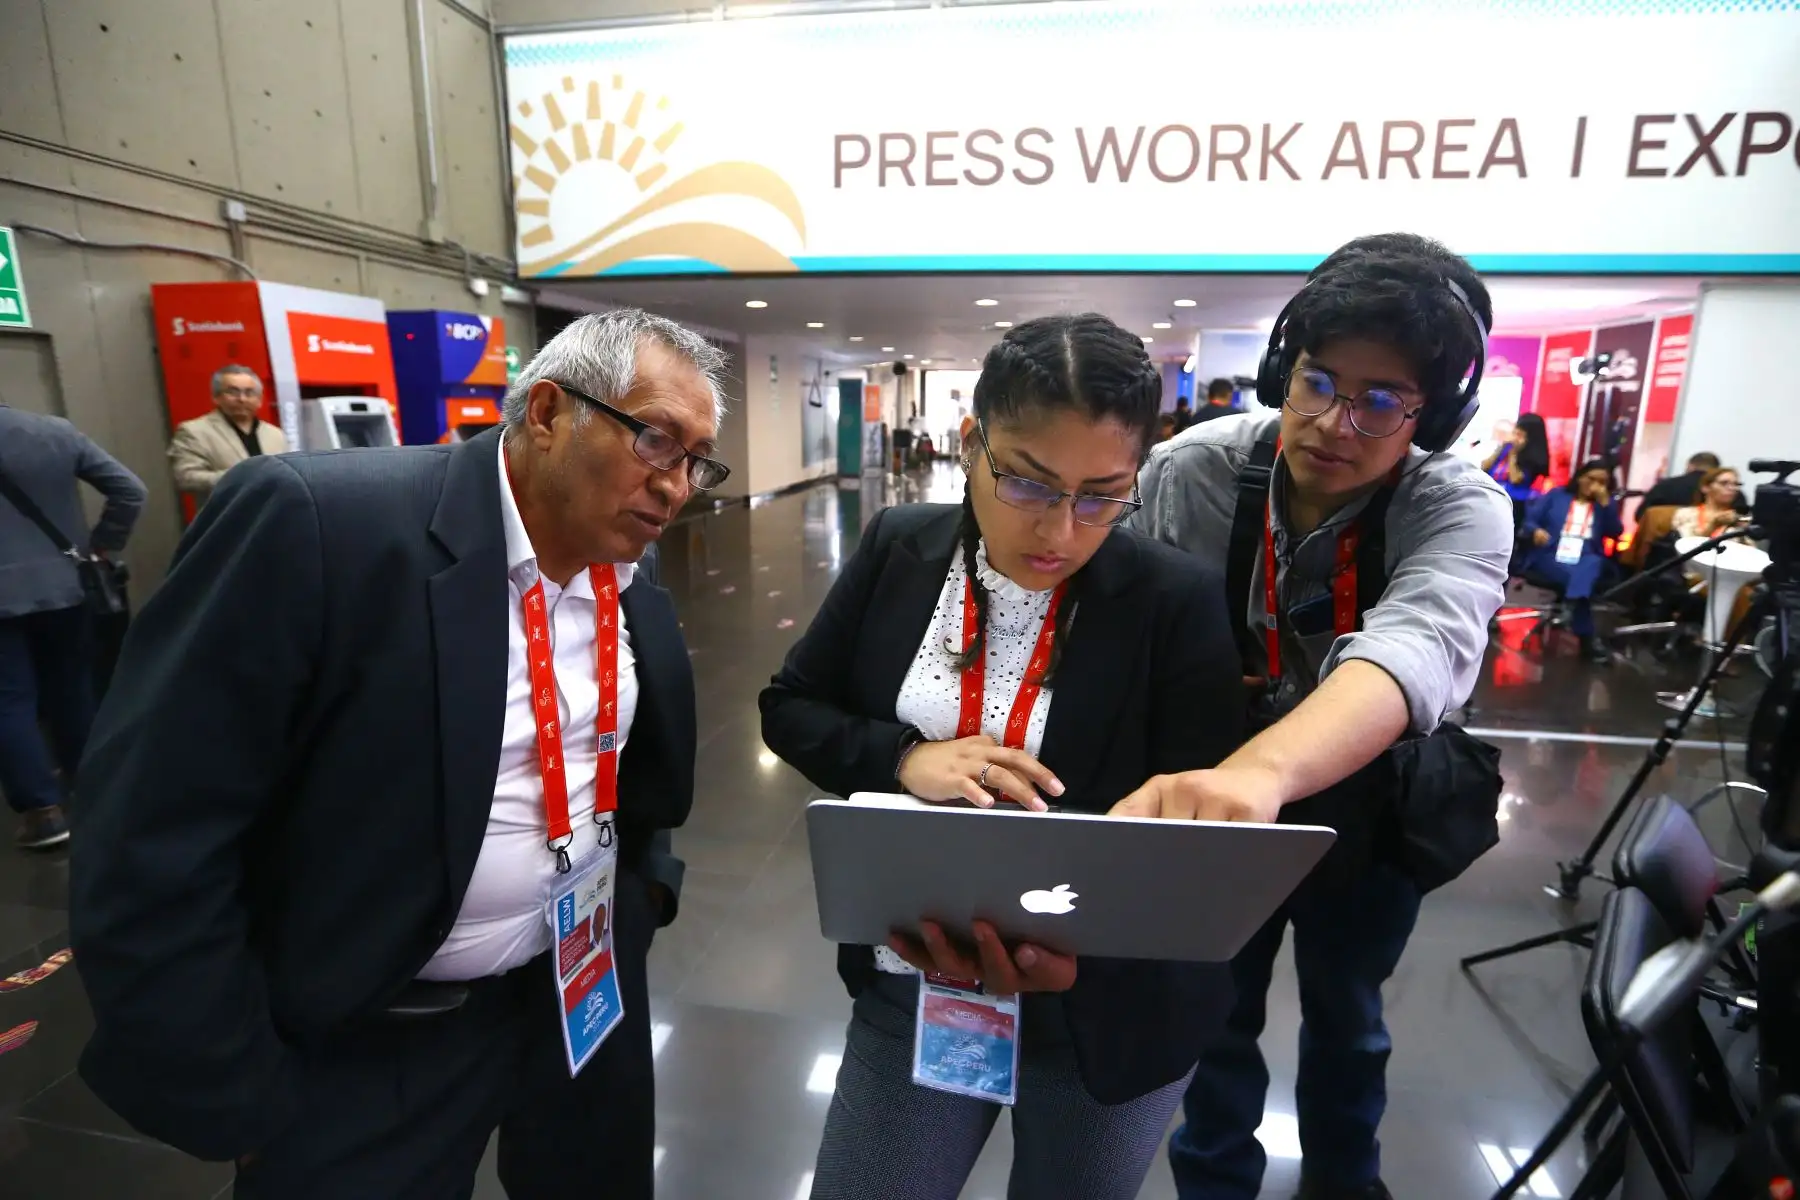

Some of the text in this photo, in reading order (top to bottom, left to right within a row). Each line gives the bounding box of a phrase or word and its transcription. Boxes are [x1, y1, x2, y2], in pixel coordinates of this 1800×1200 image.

[834, 127, 1055, 188] PRESS
[1074, 122, 1303, 184] WORK
[1320, 117, 1528, 180] AREA
[1626, 111, 1800, 178] EXP
[562, 898, 571, 933] AELW
[580, 968, 597, 988] MEDIA
[955, 1009, 983, 1021] MEDIA
